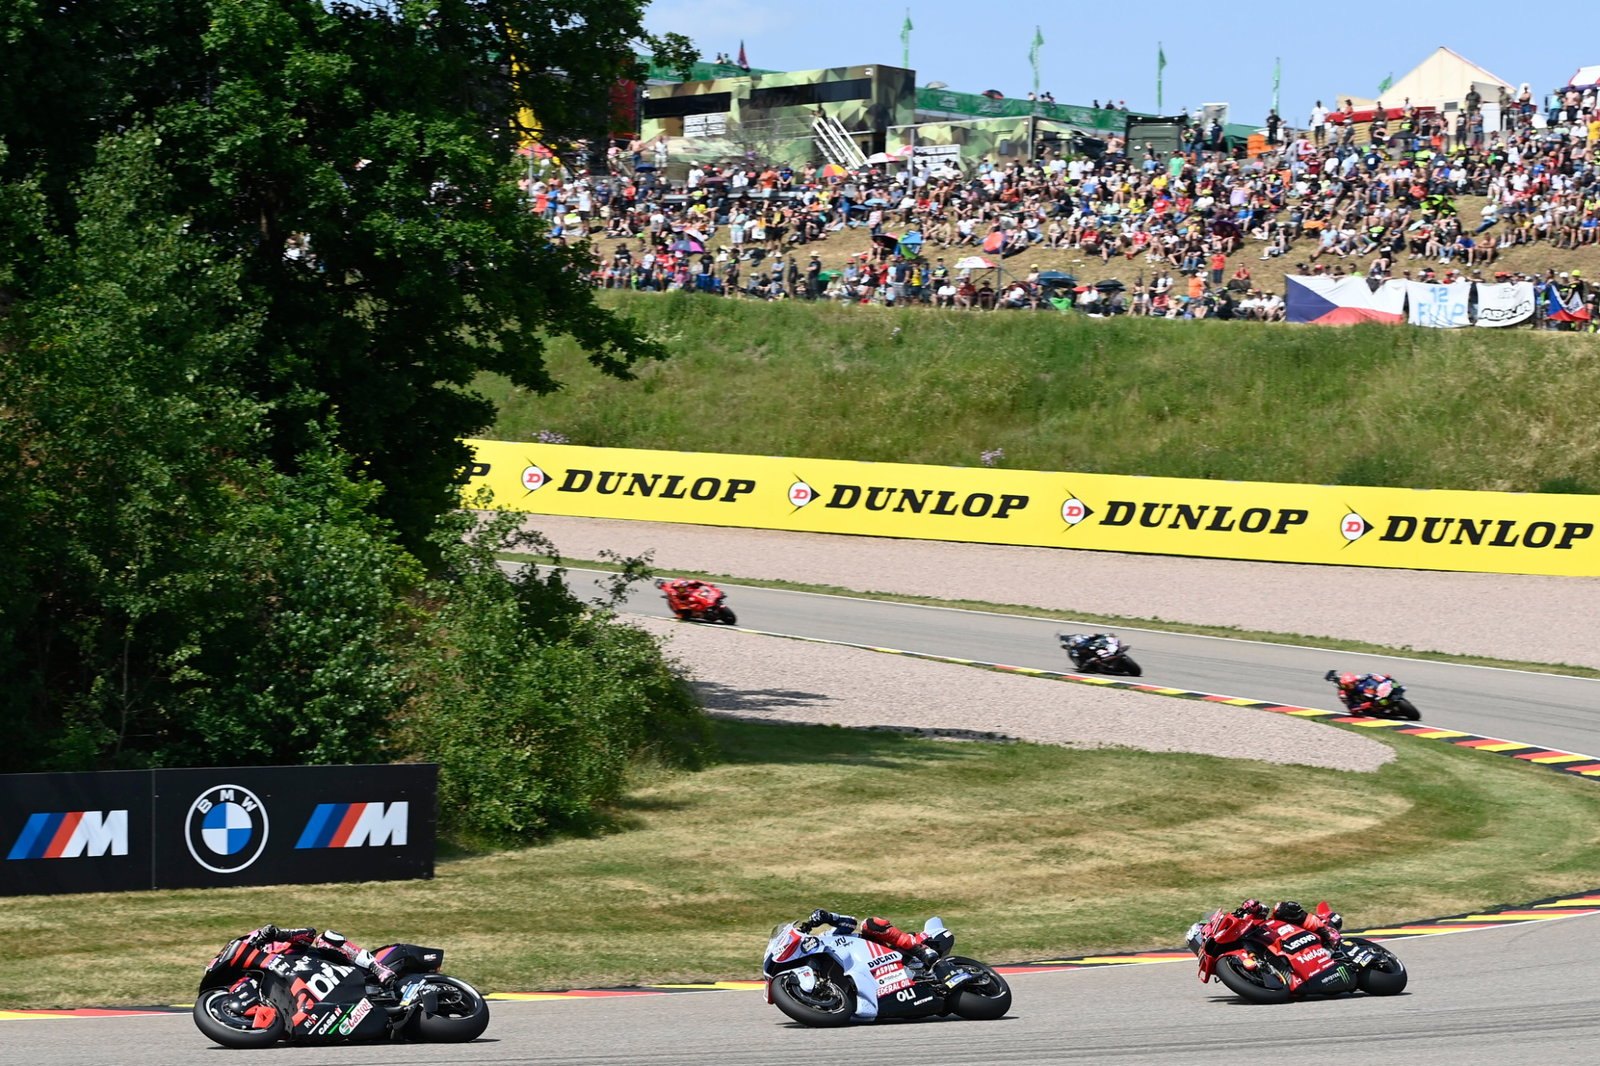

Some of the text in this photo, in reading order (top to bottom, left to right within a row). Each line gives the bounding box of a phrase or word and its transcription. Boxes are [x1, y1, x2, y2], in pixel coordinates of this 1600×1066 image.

[1430, 287, 1449, 303] 12
[526, 468, 756, 503] D DUNLOP
[792, 484, 1030, 519] D DUNLOP
[1065, 500, 1309, 535] D DUNLOP
[1345, 515, 1595, 550] D DUNLOP
[196, 788, 259, 815] BMW
[1283, 934, 1317, 951] Lenovo
[867, 952, 898, 968] DUCATI
[896, 987, 917, 1002] OLI
